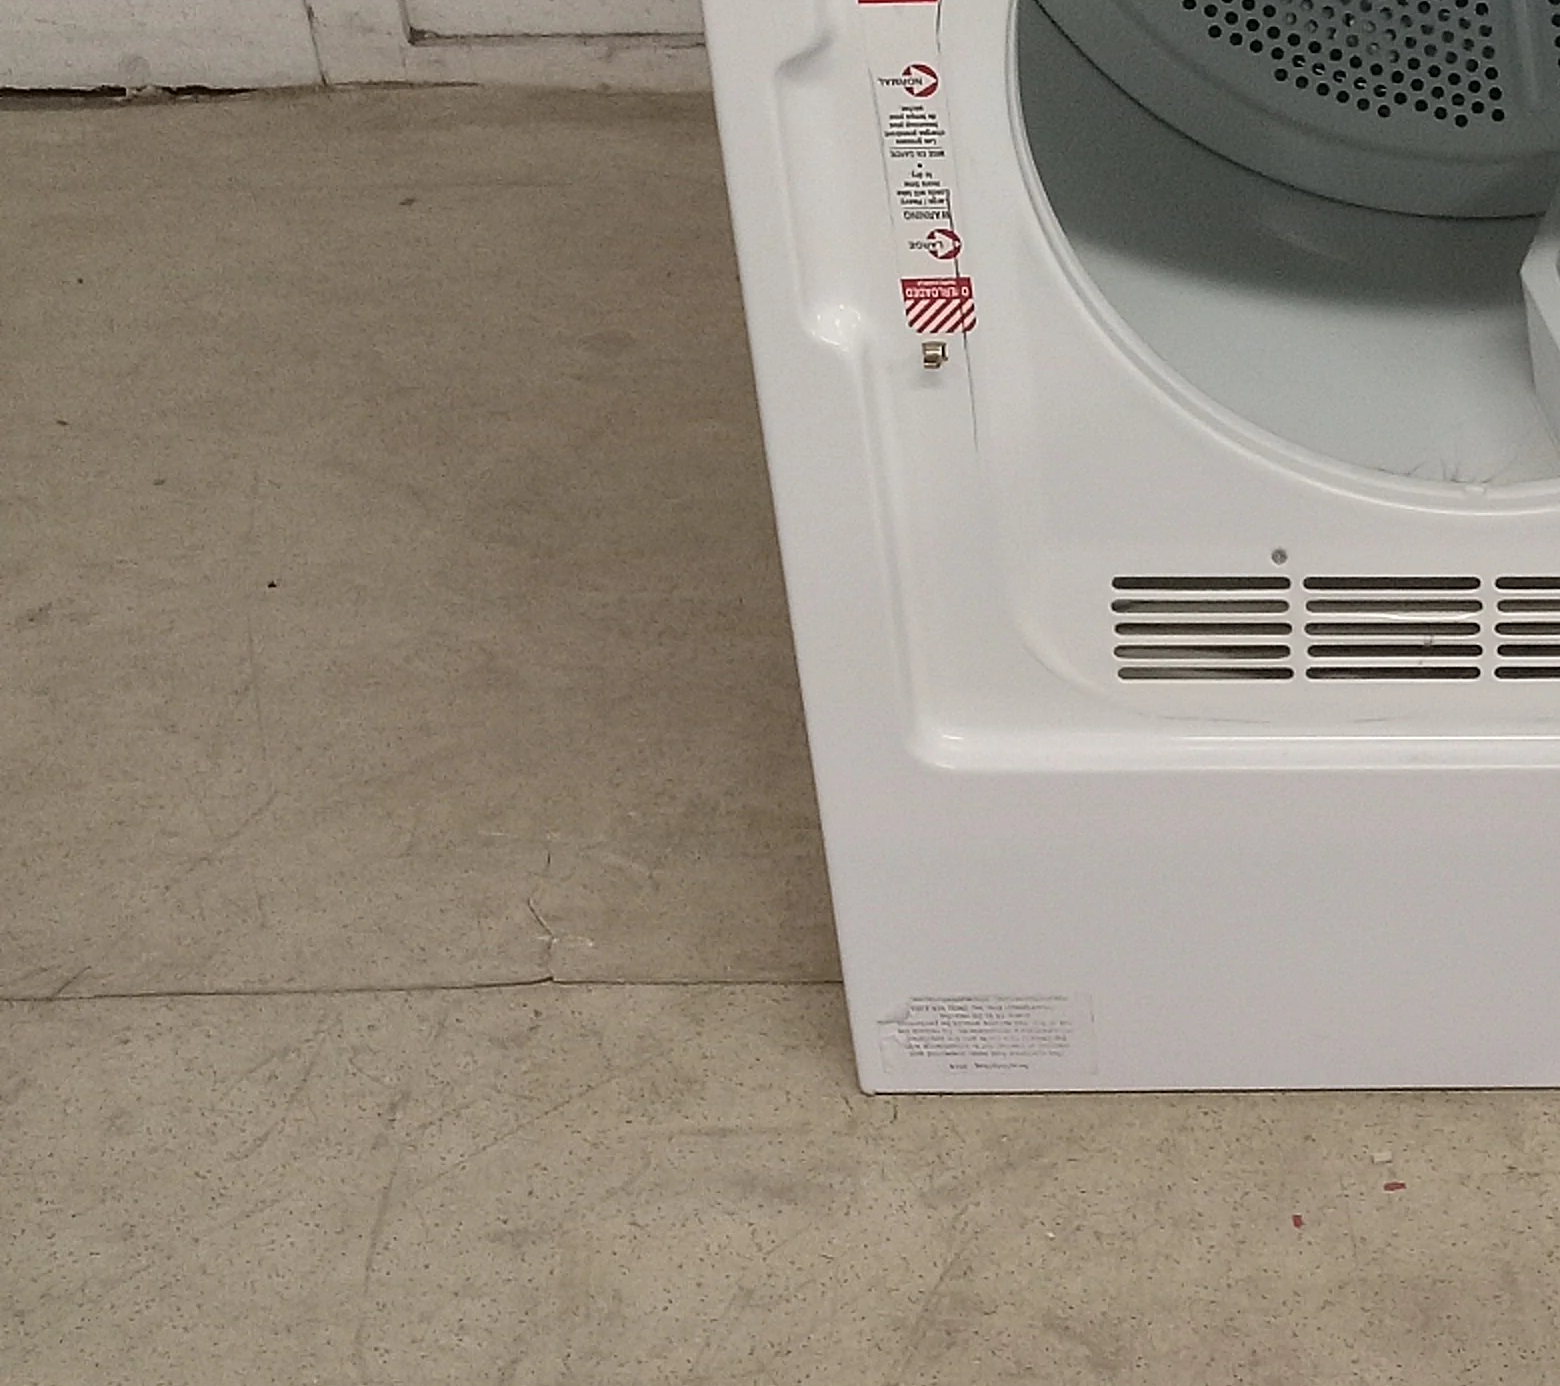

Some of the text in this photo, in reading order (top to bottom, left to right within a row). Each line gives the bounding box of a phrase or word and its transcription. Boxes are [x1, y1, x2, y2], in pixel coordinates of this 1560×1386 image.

[903, 211, 949, 219] WARNING
[908, 241, 944, 249] LARGE
[906, 286, 969, 297] OERLOADED
